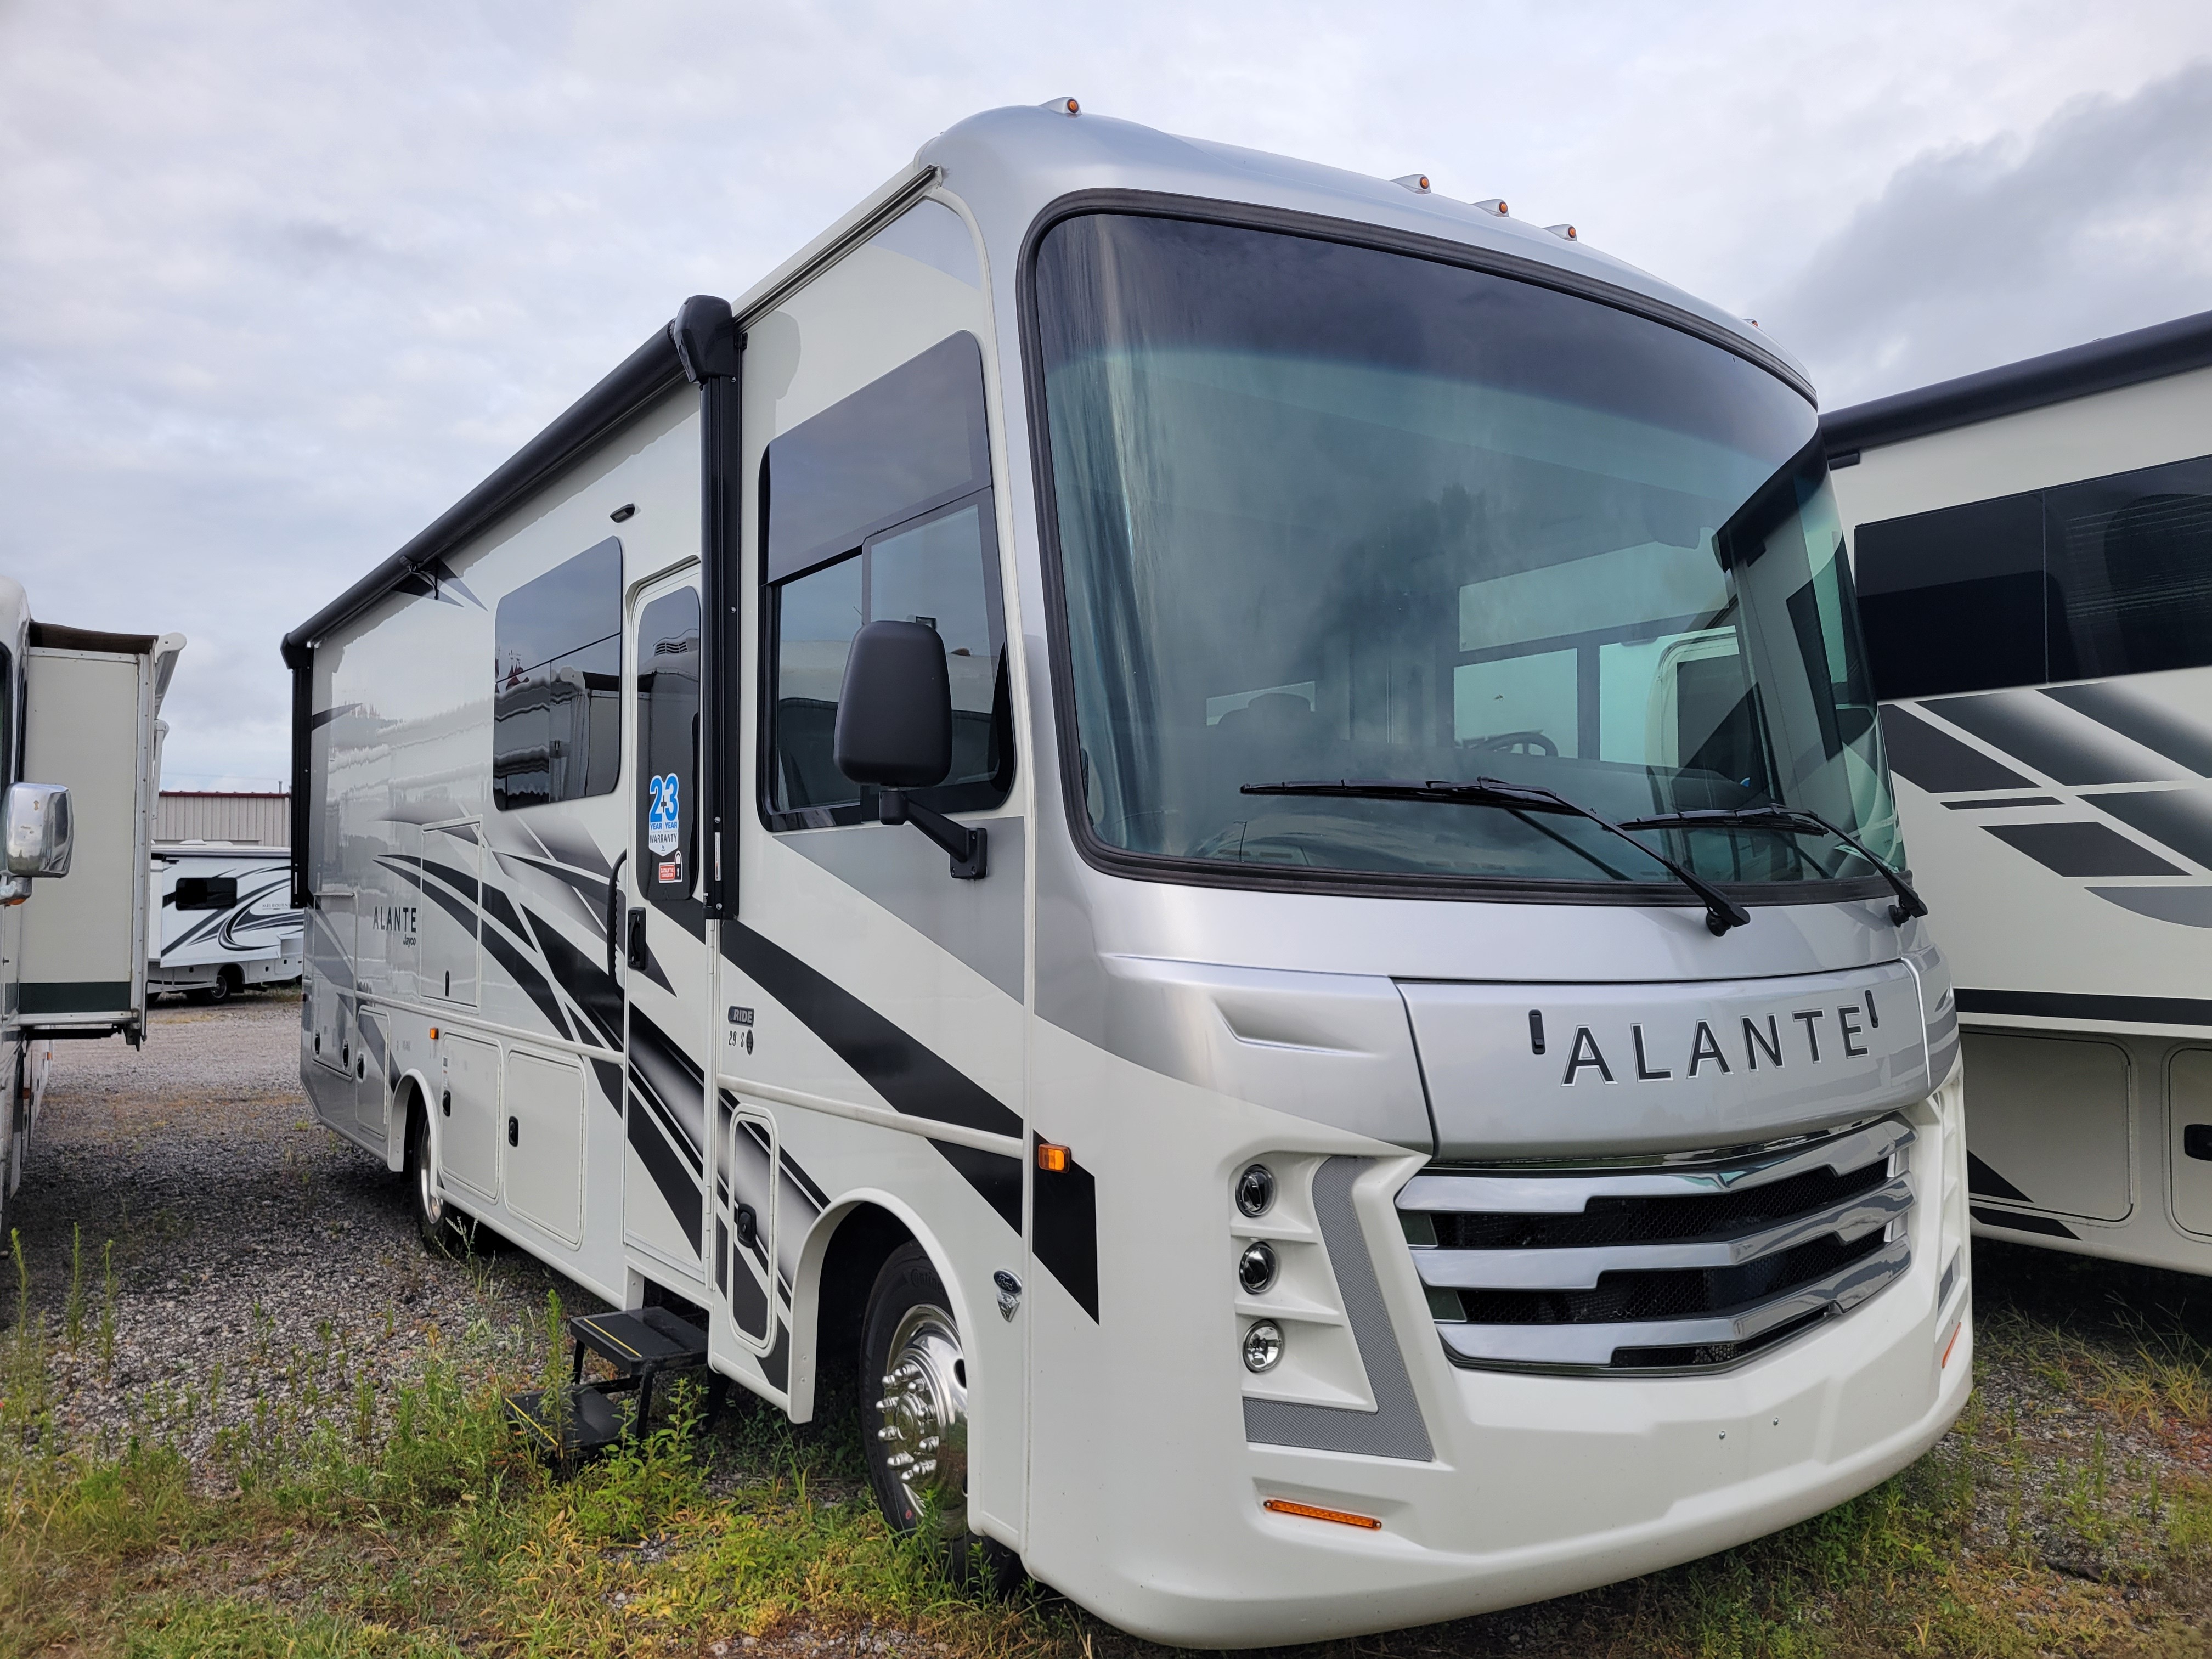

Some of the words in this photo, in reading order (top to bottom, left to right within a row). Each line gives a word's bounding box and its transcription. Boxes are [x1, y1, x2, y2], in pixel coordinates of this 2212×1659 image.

[650, 833, 677, 843] WARRANTY
[373, 906, 416, 933] ALANTE
[403, 934, 416, 948] Jayco
[1561, 1005, 1869, 1087] ALANTE
[998, 1273, 1014, 1291] Ford
